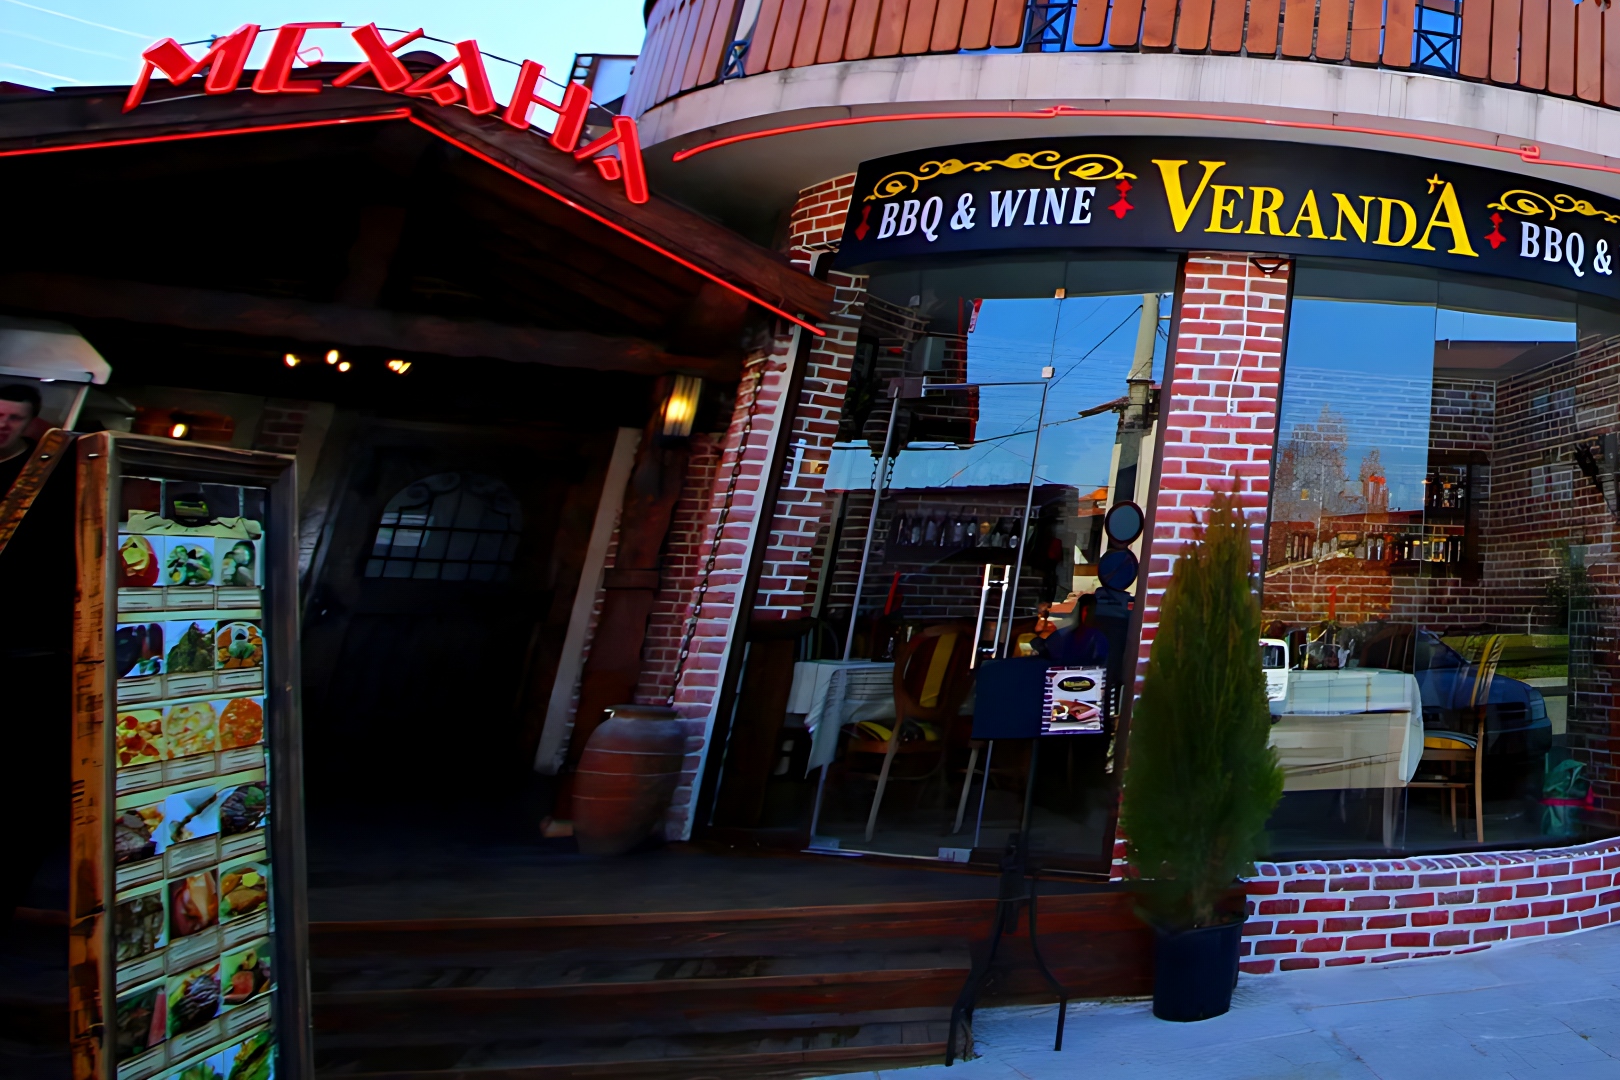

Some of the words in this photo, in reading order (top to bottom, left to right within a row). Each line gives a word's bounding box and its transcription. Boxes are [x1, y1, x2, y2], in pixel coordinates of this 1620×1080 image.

[121, 21, 650, 204] МЕХАНА
[876, 195, 944, 242] BBQ
[949, 192, 977, 230] &
[989, 186, 1097, 228] WINE
[1151, 158, 1480, 258] VERANDA
[1519, 221, 1585, 278] BBQ
[1593, 238, 1613, 276] &
